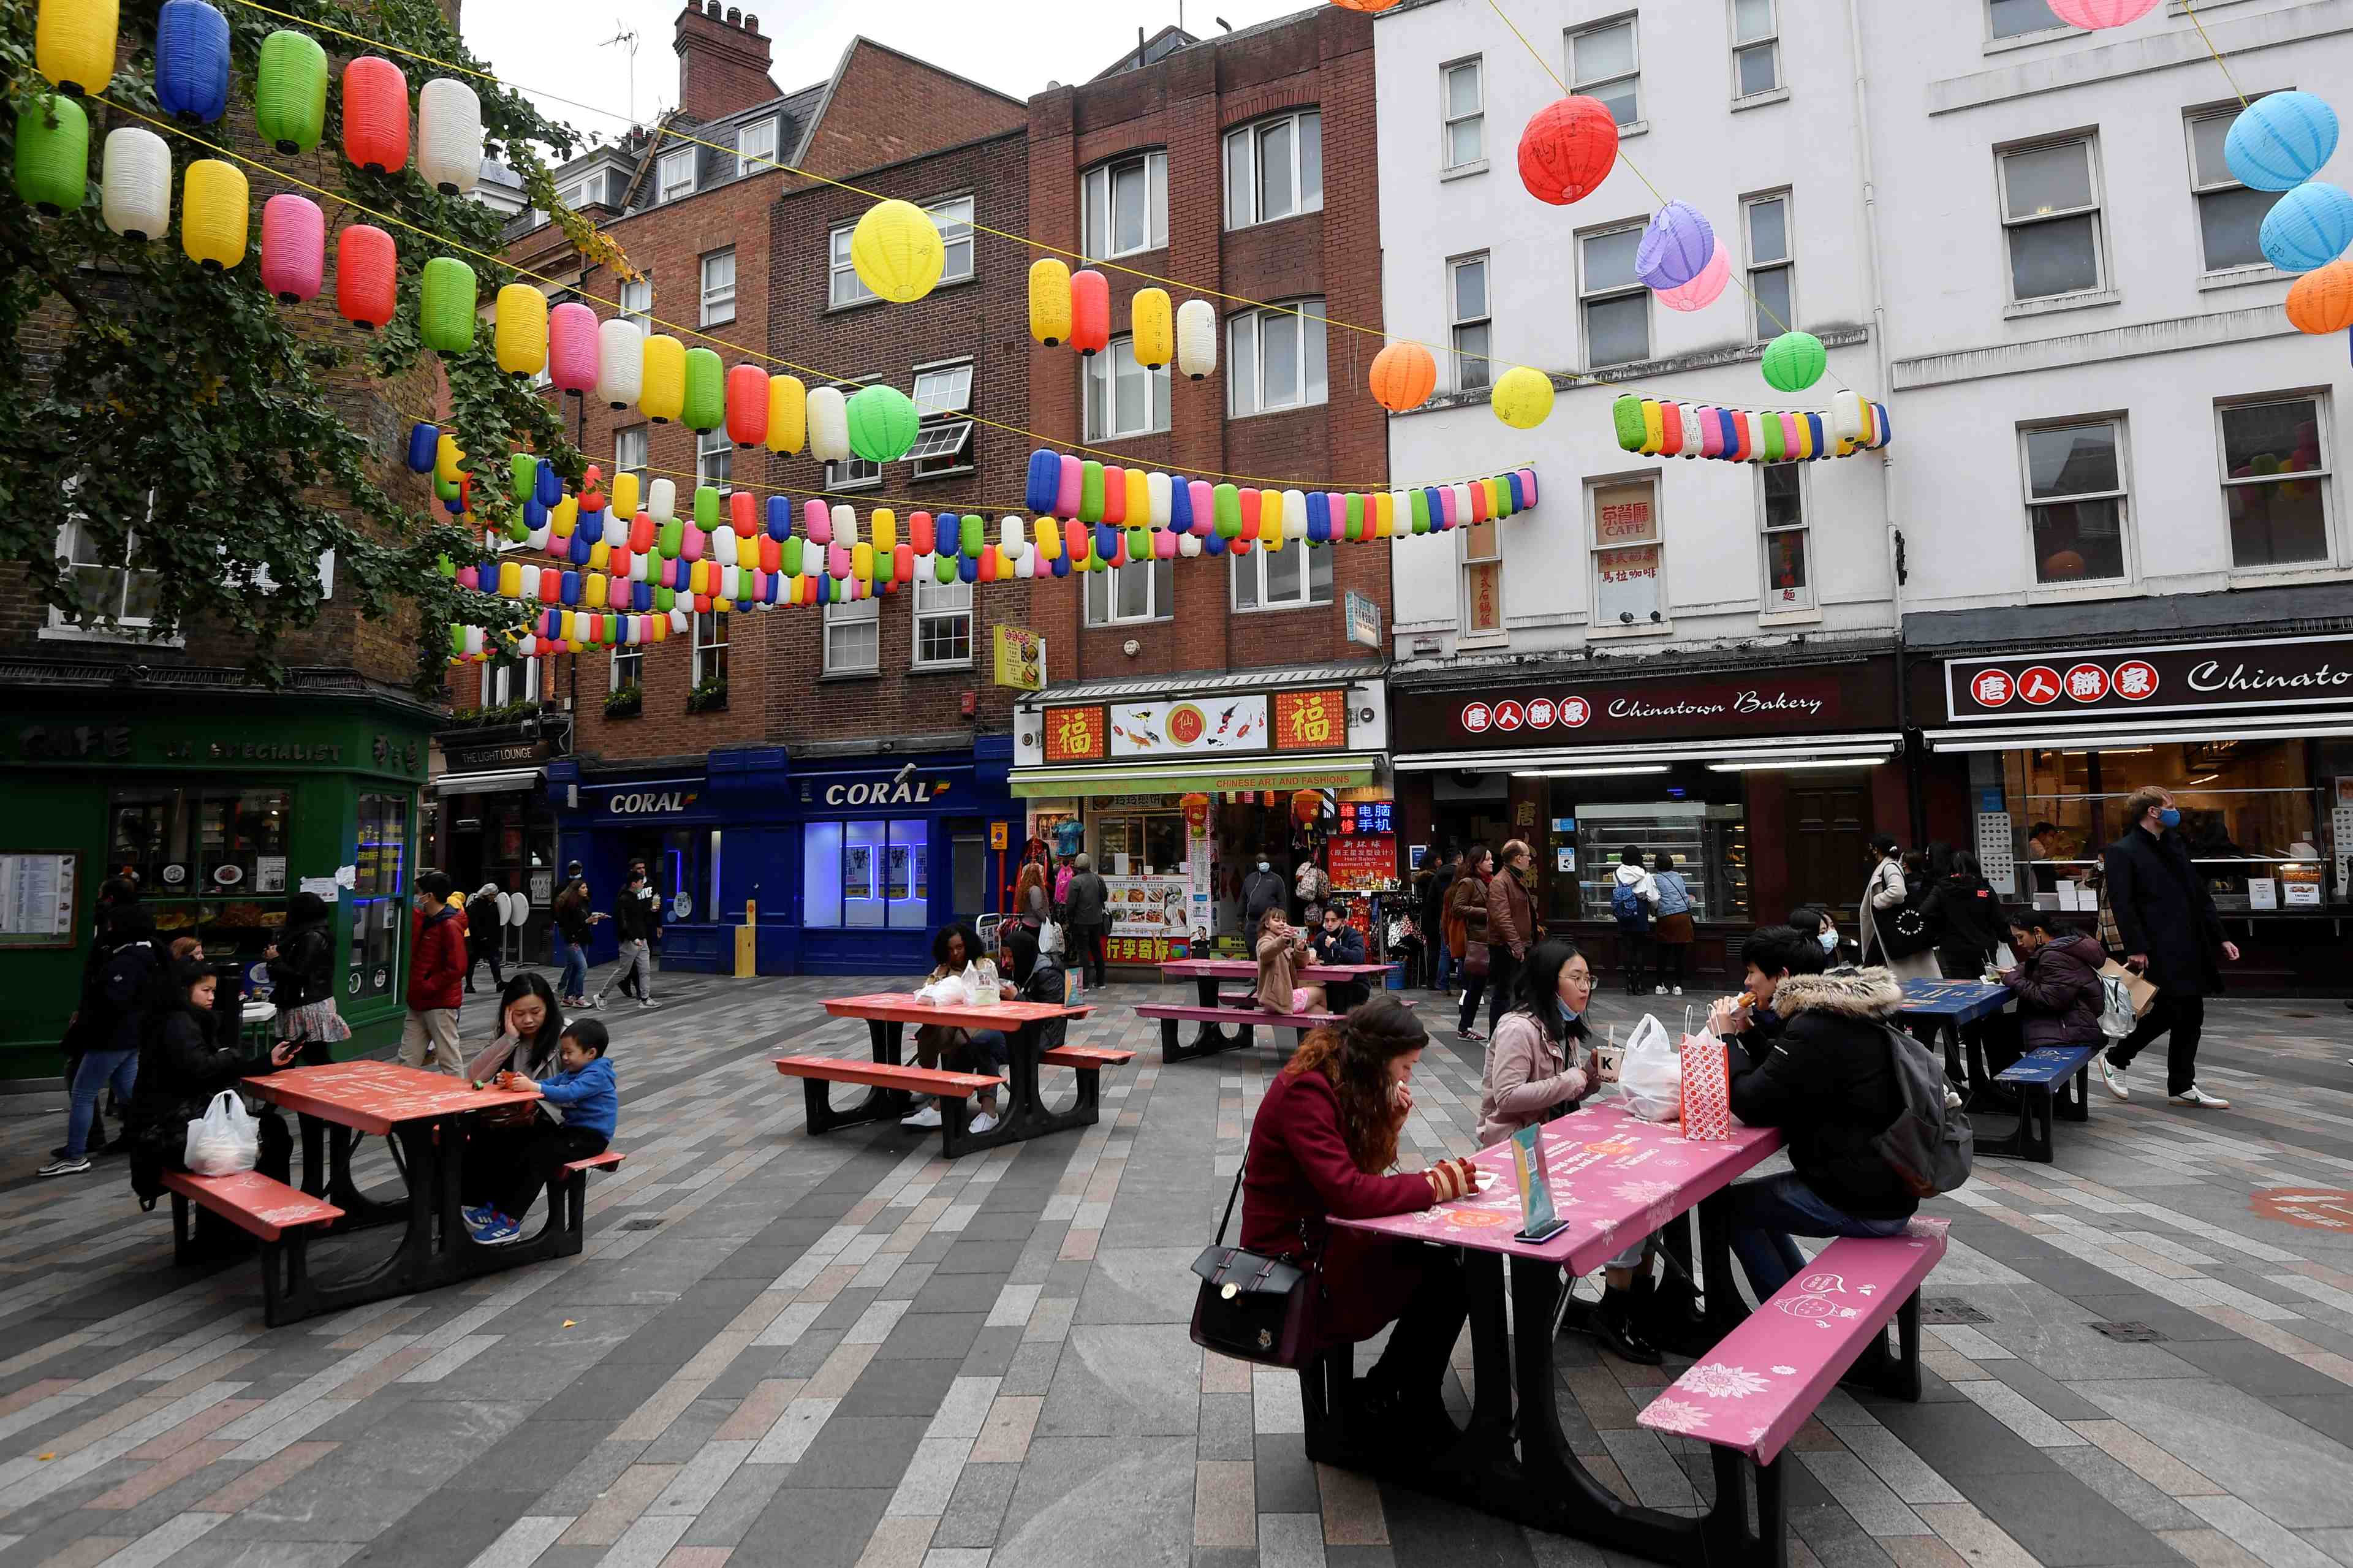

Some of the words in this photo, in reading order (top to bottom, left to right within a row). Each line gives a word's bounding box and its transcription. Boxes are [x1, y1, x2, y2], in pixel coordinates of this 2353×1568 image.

[1605, 523, 1645, 536] CAFE
[1608, 697, 1726, 718] Chinatown
[1733, 690, 1824, 714] Bakery
[1290, 695, 1329, 742] 福
[1058, 712, 1091, 754] 福
[461, 752, 477, 763] THE
[478, 750, 500, 762] LIGHT
[501, 747, 532, 760] LOUNGE
[1216, 779, 1256, 788] CHINESE
[1259, 778, 1276, 787] ART
[1279, 777, 1298, 786] AND
[1302, 775, 1350, 785] FASHIONS
[826, 781, 930, 805] CORAL
[610, 792, 684, 814] CORAL
[1358, 805, 1390, 817] 电脑
[1358, 819, 1391, 831] 手机
[1895, 909, 1920, 923] LABOUR
[1897, 926, 1911, 936] AND
[1912, 921, 1924, 934] WAIT
[1602, 1057, 1613, 1070] K
